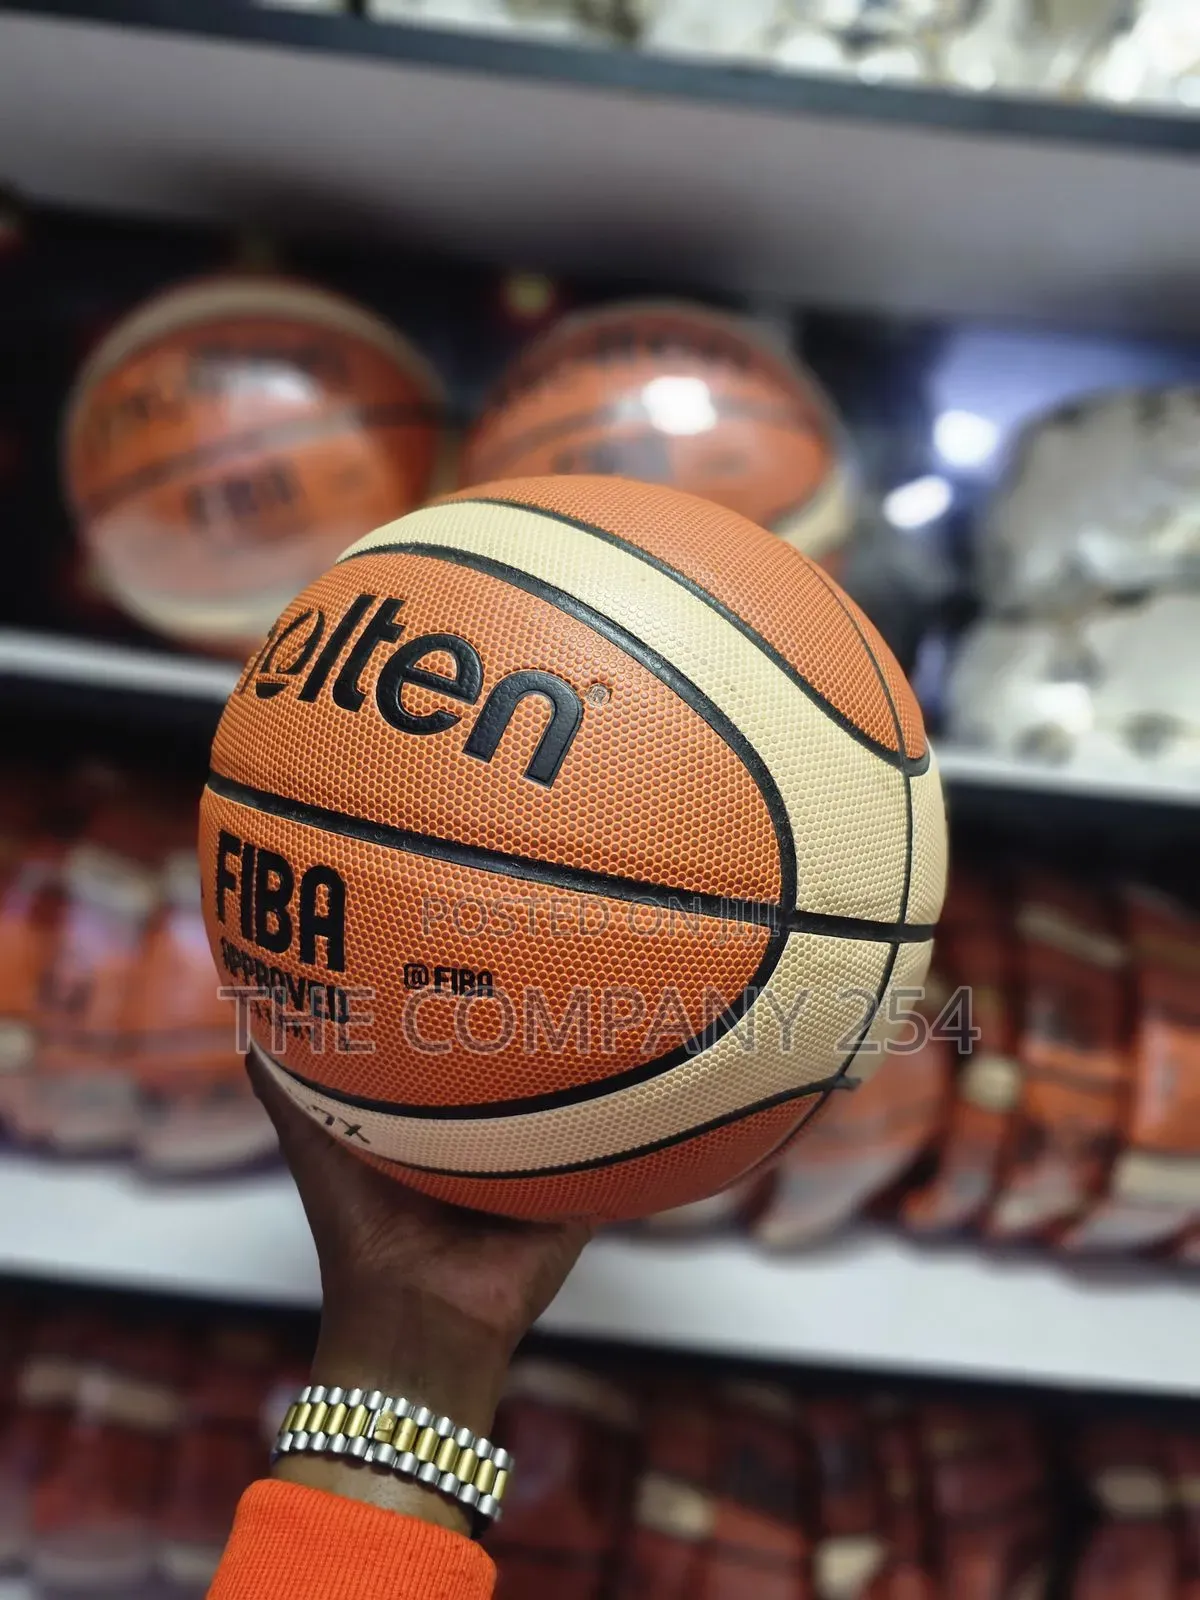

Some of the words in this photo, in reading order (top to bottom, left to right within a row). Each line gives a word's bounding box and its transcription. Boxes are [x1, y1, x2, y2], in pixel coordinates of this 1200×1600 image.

[240, 594, 585, 788] olten
[217, 828, 346, 972] FIBA
[219, 937, 349, 1024] APPROVED
[434, 966, 493, 997] FIBA
